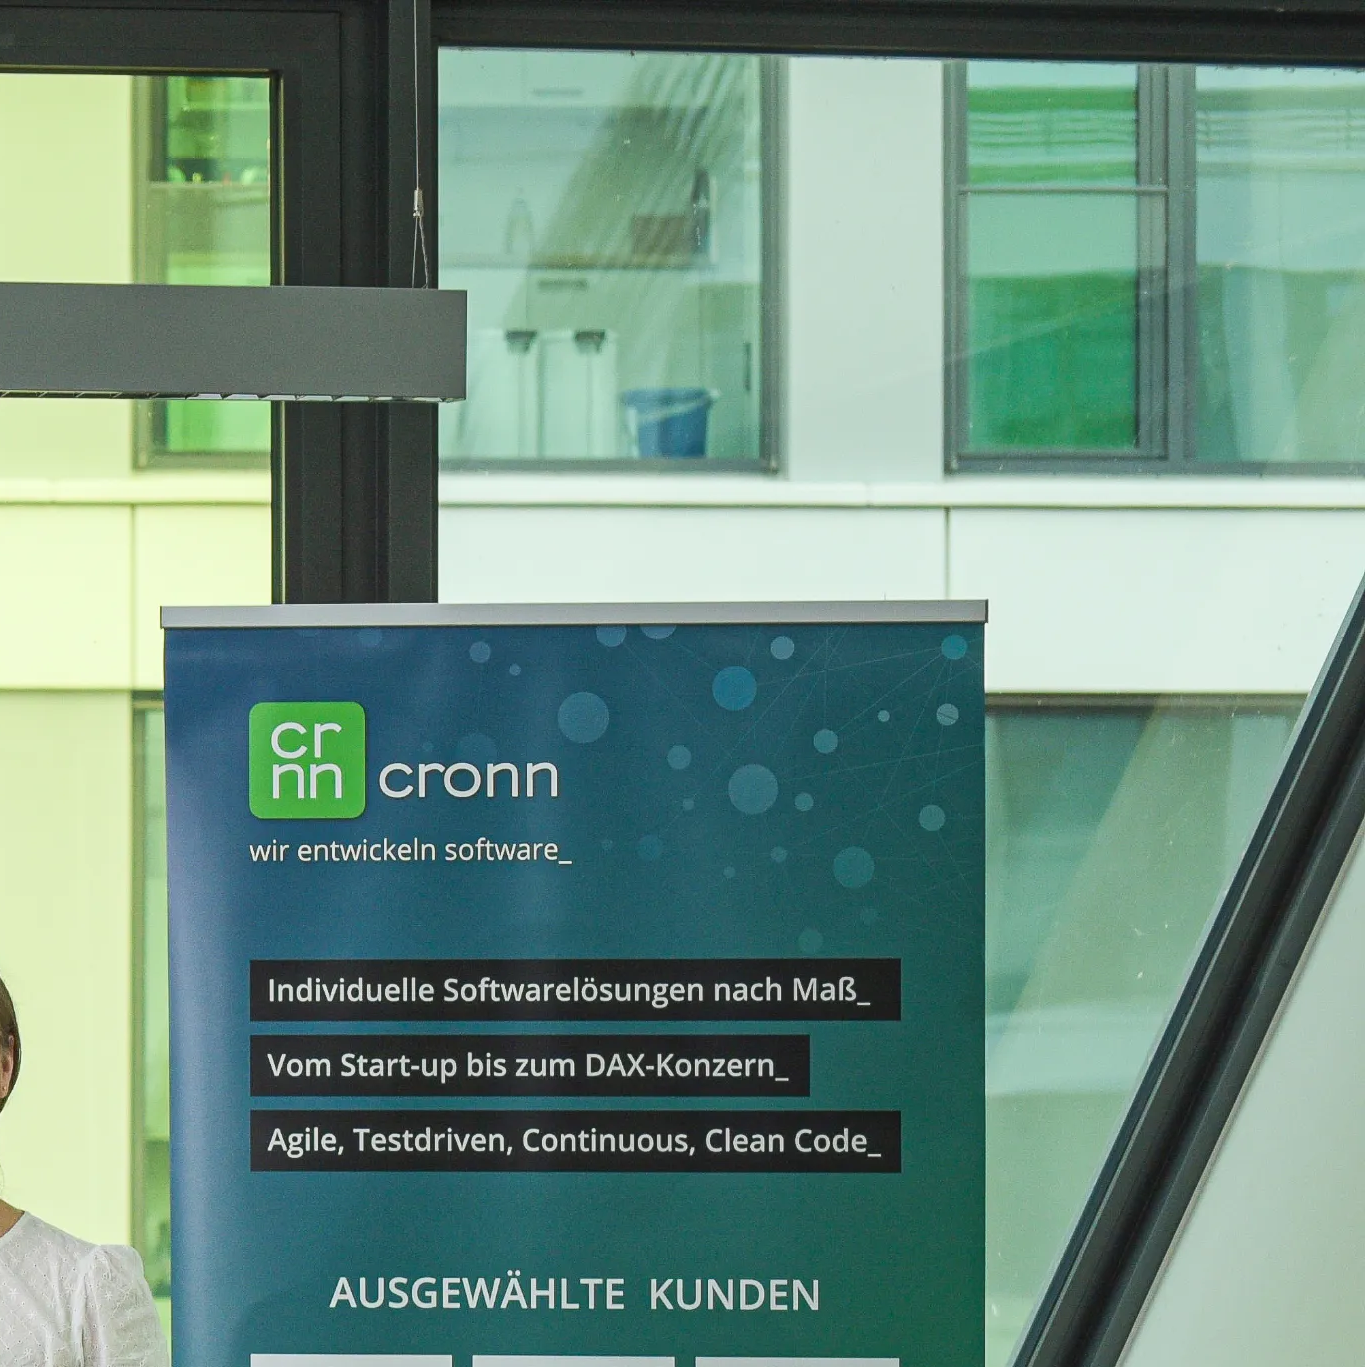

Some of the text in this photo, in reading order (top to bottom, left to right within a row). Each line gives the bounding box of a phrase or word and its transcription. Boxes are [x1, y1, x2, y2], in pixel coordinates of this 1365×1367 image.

[379, 762, 557, 798] cronn
[250, 837, 572, 864] wir entwickeln software_
[270, 976, 870, 1008] Individuelle Softwarelösungen nach Maß_
[267, 1052, 789, 1083] Vom Start-up bis zum DAX-Konzern_
[268, 1127, 881, 1158] Agile, Testdriven, Continuous, Clean Code_
[330, 1270, 818, 1310] AUSGEWÄHLTE KUNDEN
